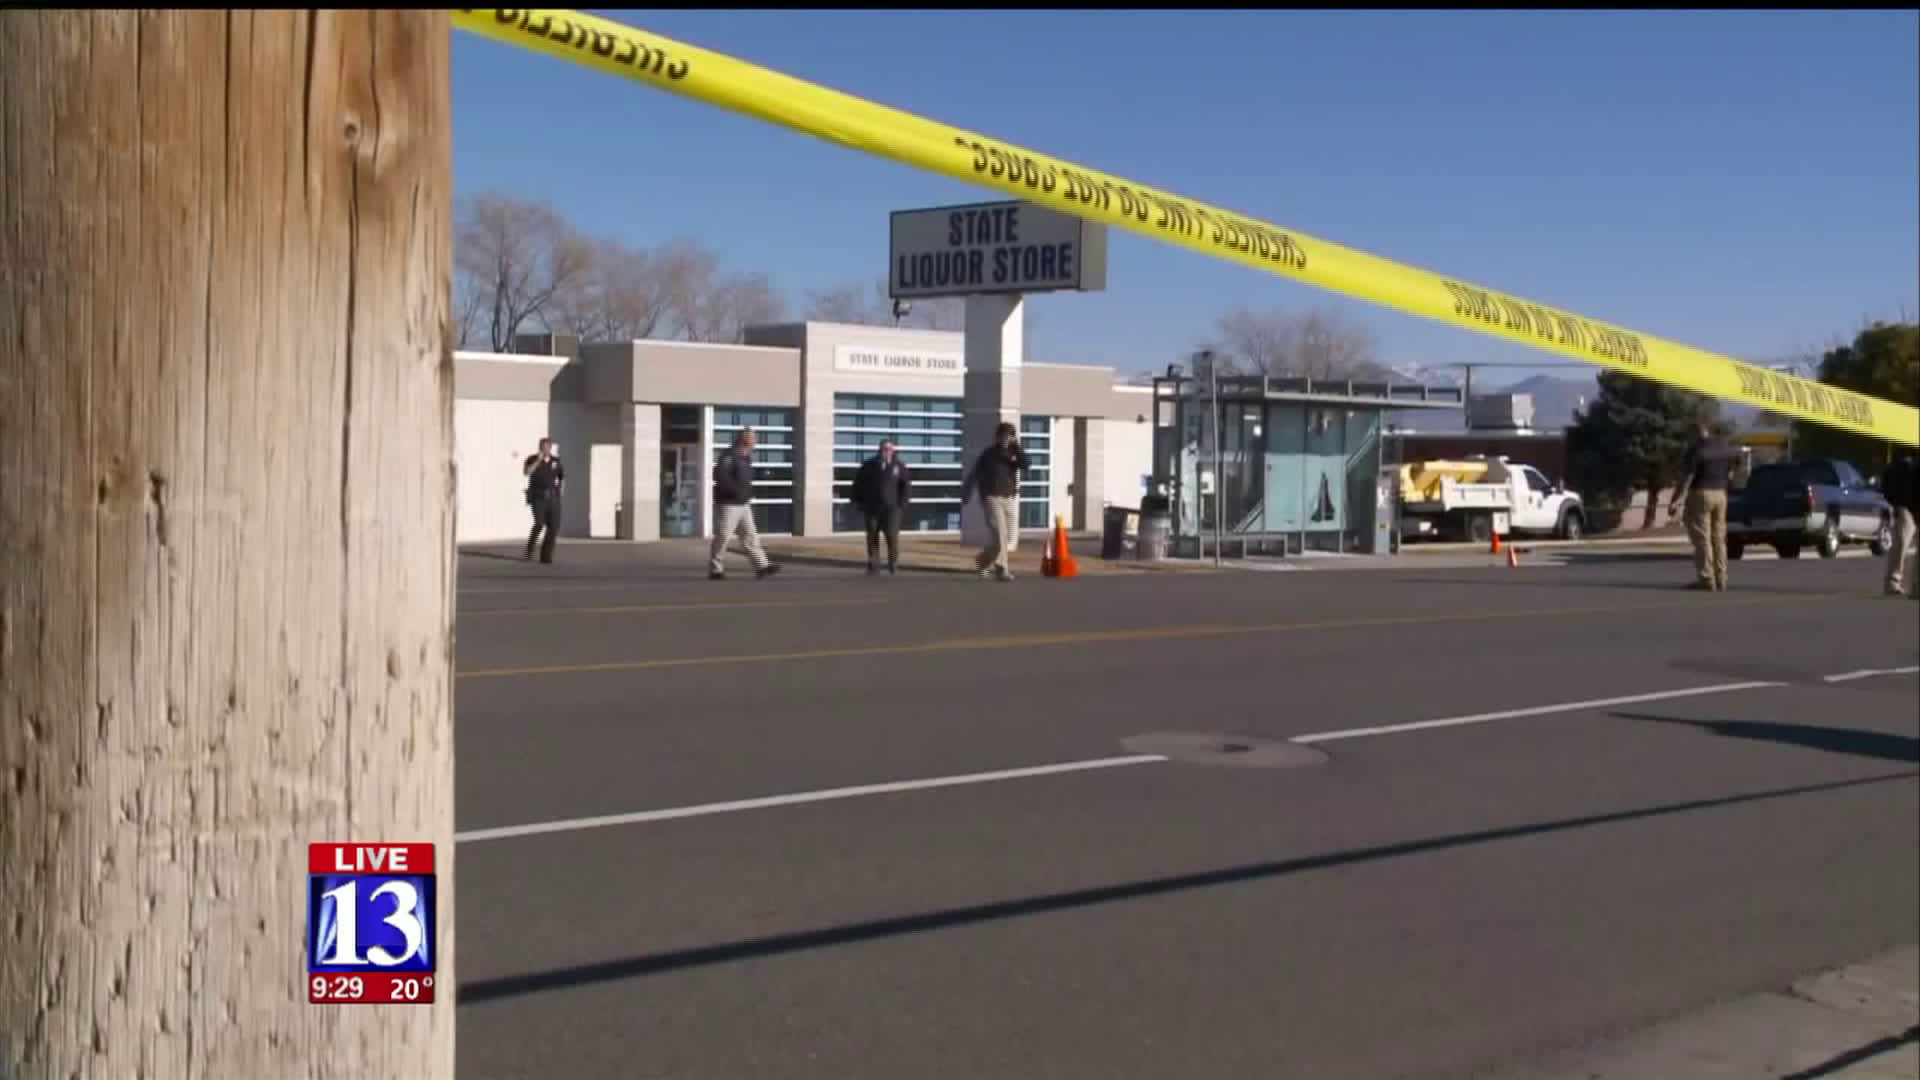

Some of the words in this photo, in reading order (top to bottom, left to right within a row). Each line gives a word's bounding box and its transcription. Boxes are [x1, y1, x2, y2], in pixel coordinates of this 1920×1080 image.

[949, 207, 1020, 246] STATE
[899, 249, 983, 289] LIQUOR
[992, 243, 1073, 283] STORE
[849, 353, 880, 366] STATE
[883, 354, 922, 368] LIQUOR
[926, 357, 957, 369] STORE
